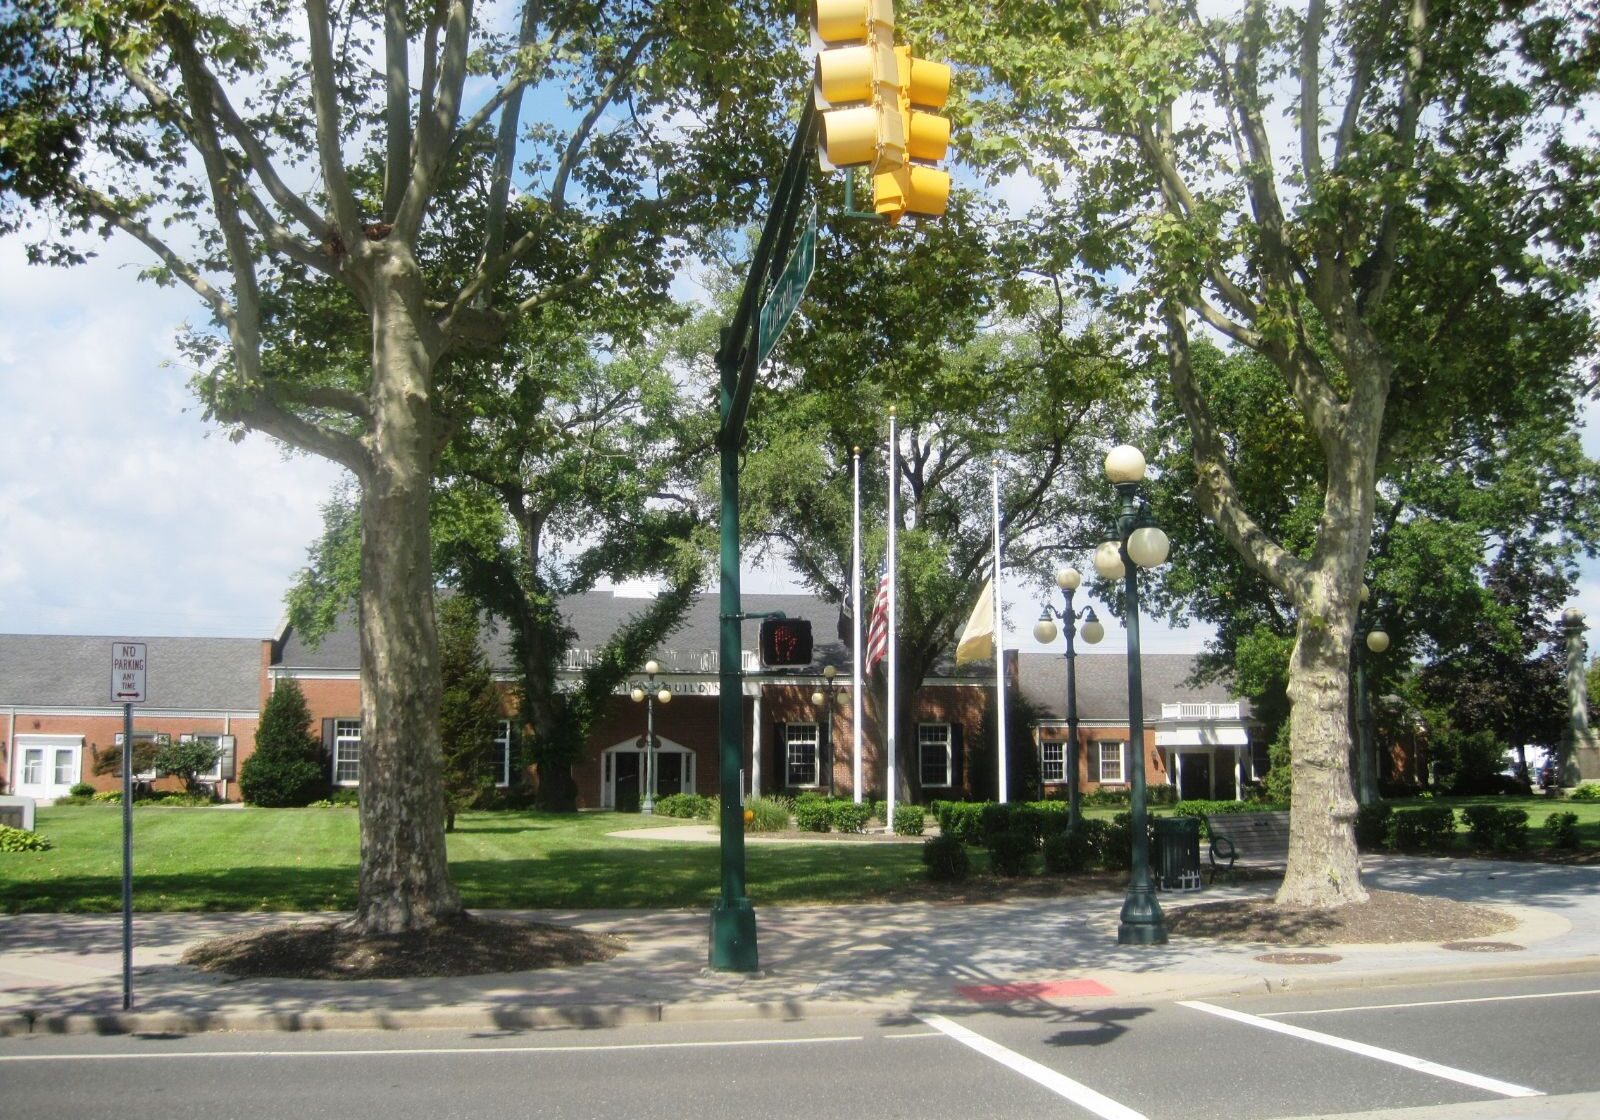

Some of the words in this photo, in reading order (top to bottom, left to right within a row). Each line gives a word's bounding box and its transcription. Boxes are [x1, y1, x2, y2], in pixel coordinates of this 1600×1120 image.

[122, 646, 136, 657] NO
[114, 659, 144, 671] PARKING
[122, 673, 135, 681] ANY
[122, 682, 136, 690] TIME
[664, 684, 720, 693] BUILDIN
